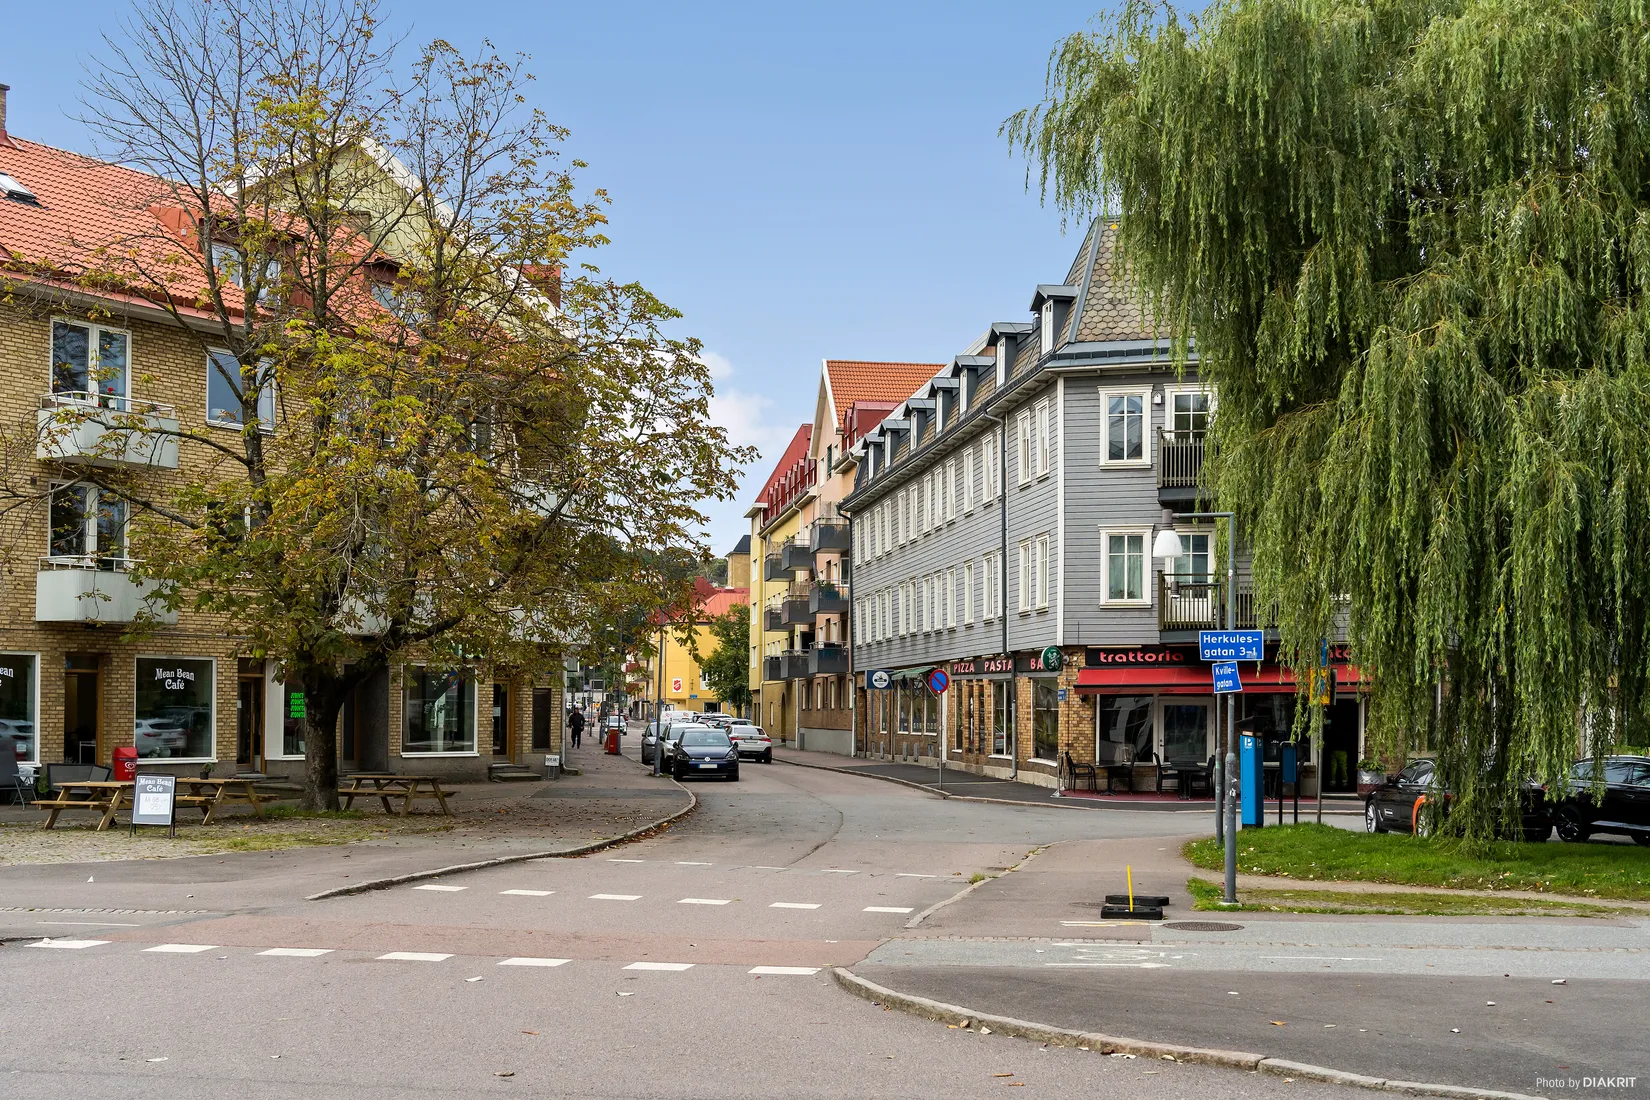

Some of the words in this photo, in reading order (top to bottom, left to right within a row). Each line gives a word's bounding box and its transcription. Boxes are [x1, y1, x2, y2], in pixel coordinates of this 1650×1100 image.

[1203, 634, 1259, 644] Herkules-
[1099, 650, 1183, 663] trattoria
[1204, 647, 1235, 658] gatan
[953, 662, 975, 674] PIZZA
[984, 658, 1012, 672] PASTA
[1030, 657, 1044, 671] BA
[1215, 665, 1235, 676] Kville-
[154, 667, 175, 681] Mean
[176, 668, 195, 681] Bean
[165, 678, 185, 690] Café
[139, 778, 156, 787] Mean
[157, 778, 172, 787] Bean
[146, 784, 164, 792] Café
